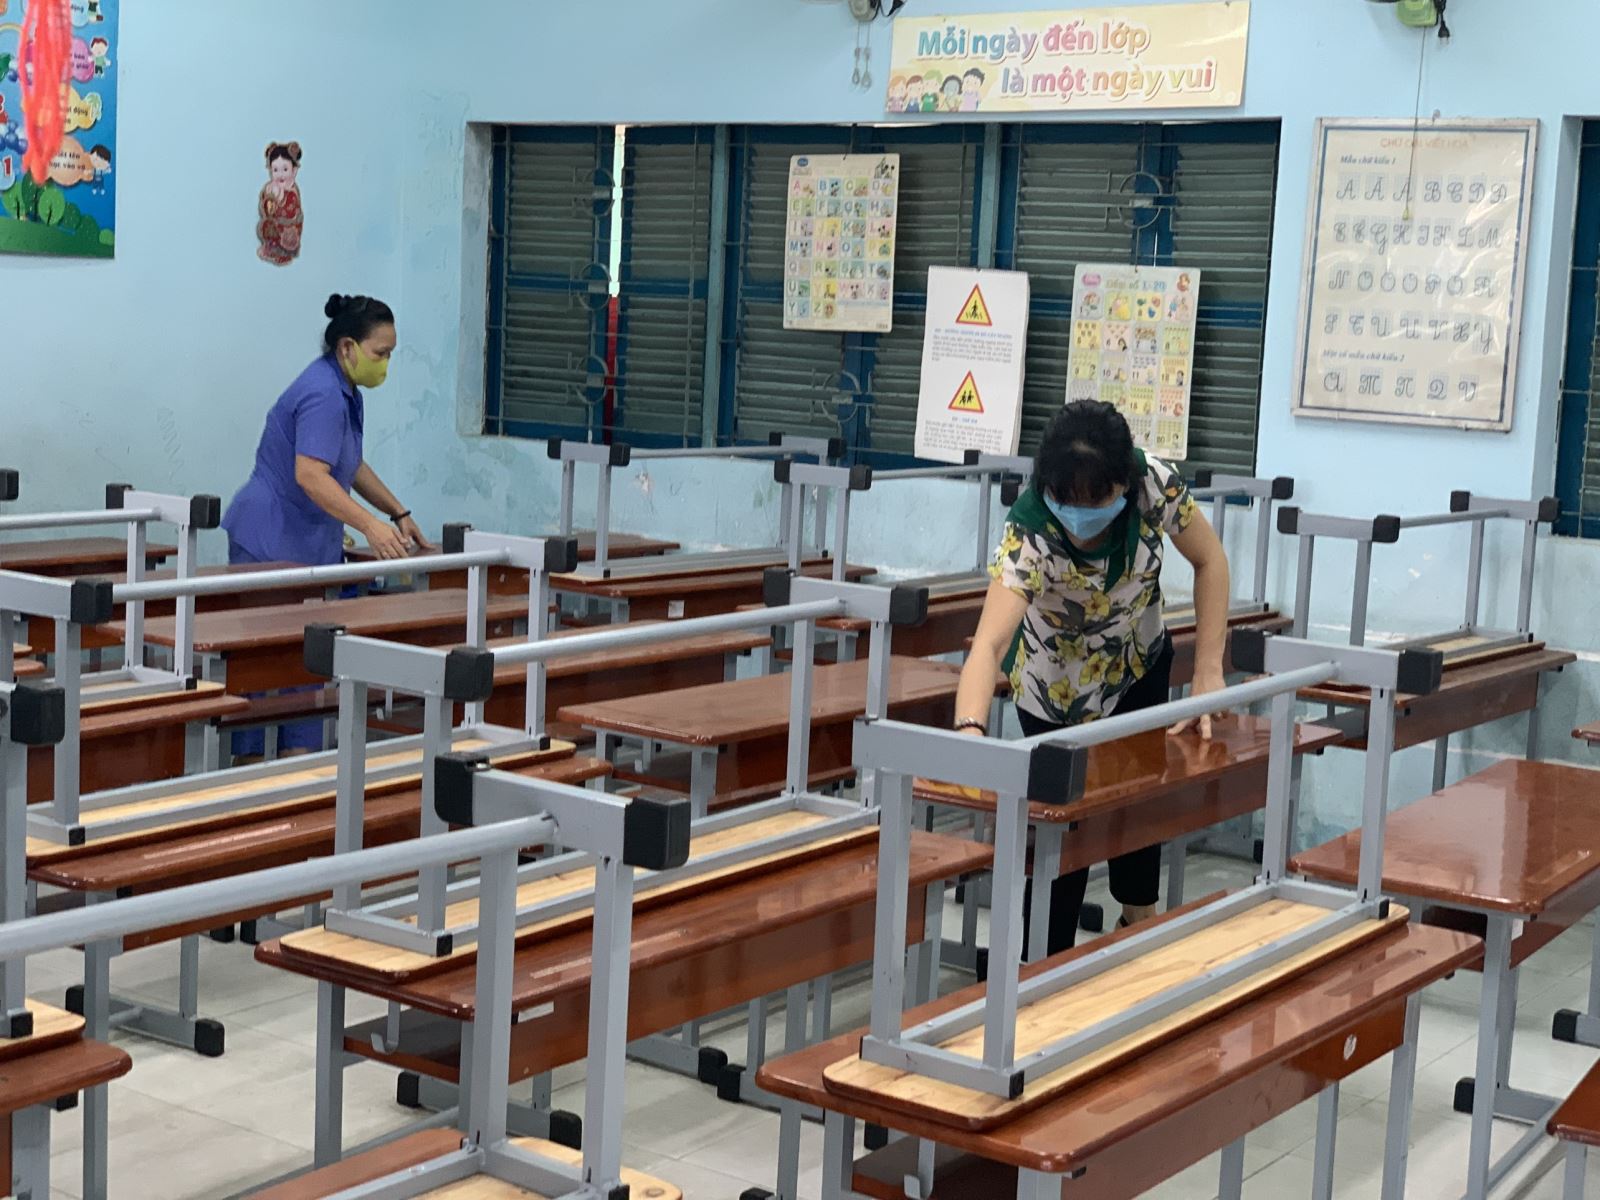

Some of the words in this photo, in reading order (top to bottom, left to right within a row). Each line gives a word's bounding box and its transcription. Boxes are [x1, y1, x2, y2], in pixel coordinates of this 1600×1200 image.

[918, 27, 966, 57] Mỗi
[972, 29, 1038, 61] ngày
[1043, 20, 1094, 52] đến
[1101, 22, 1148, 55] lớp
[1001, 67, 1024, 94] là
[1031, 66, 1086, 99] một
[1092, 64, 1163, 98] ngày
[1169, 61, 1214, 88] vui
[4, 157, 11, 175] 1
